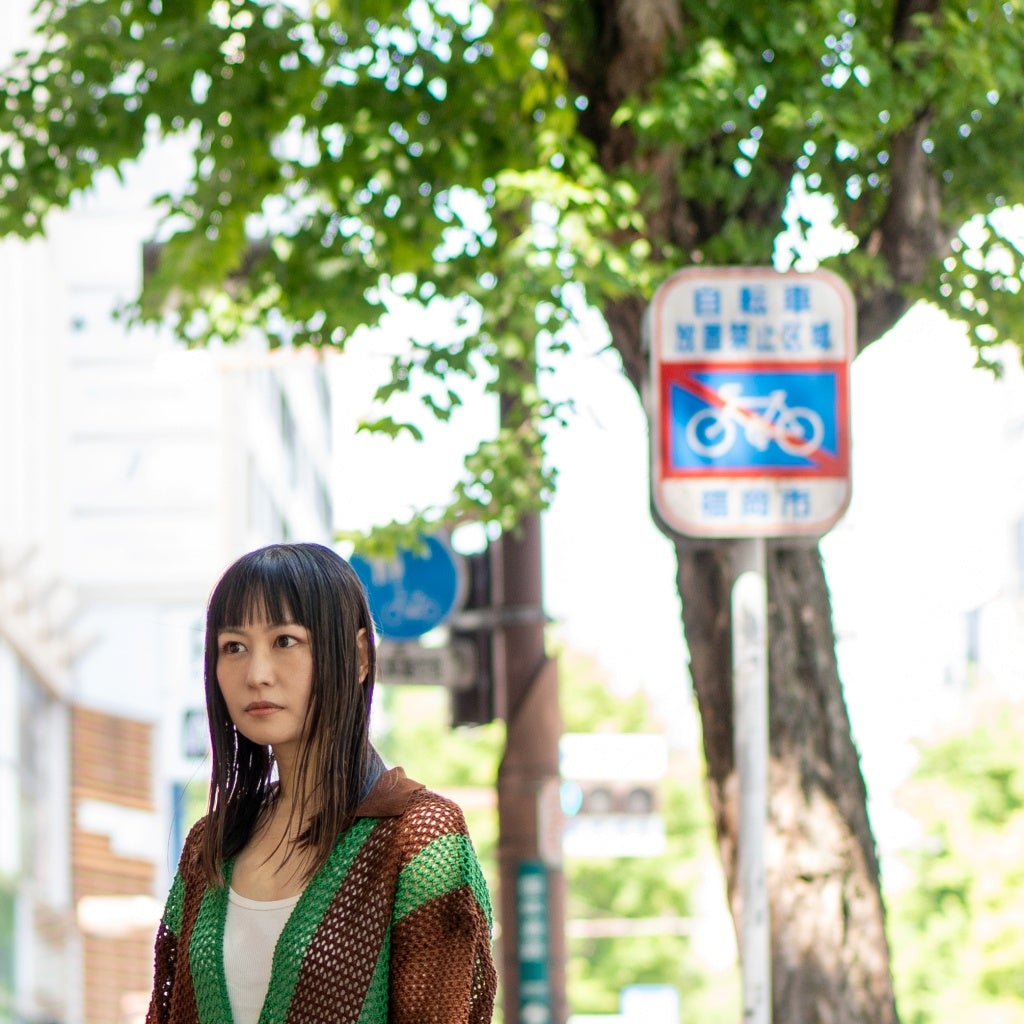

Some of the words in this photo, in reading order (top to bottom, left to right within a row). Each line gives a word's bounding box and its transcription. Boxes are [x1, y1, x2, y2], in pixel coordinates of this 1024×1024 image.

[693, 285, 812, 317] 自転車
[676, 321, 832, 352] 放置禁止区域
